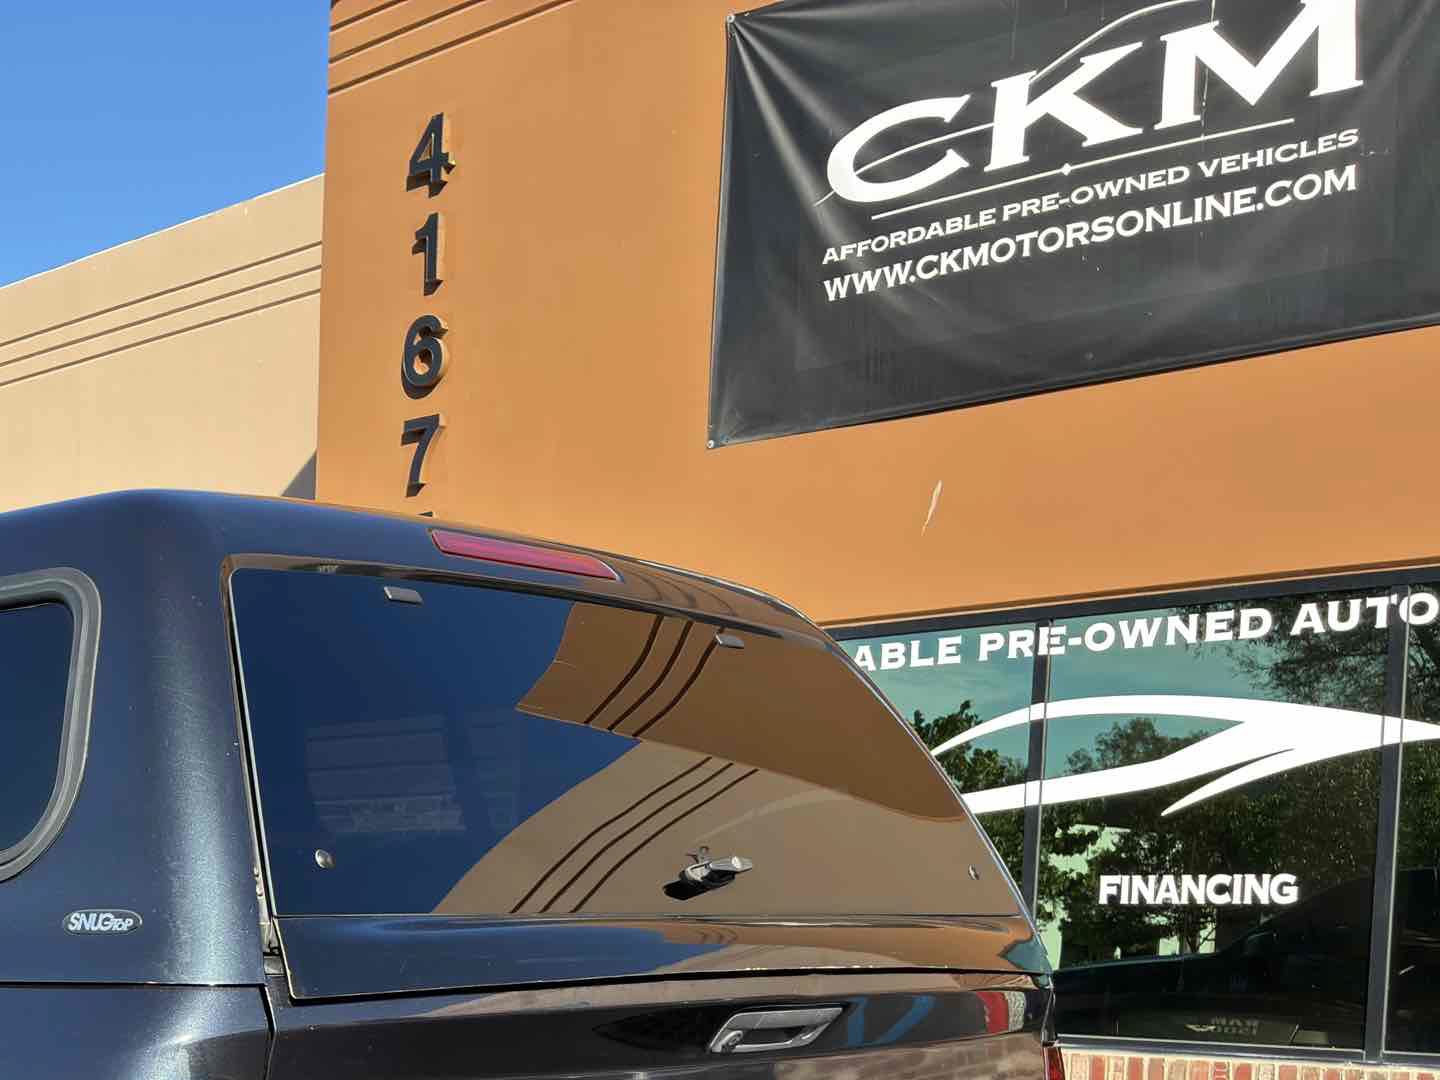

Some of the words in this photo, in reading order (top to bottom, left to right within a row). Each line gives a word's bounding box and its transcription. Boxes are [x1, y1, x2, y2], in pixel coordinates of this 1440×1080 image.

[826, 0, 1363, 203] CKM
[822, 208, 997, 265] AFFORDABLE
[1002, 166, 1191, 223] PRE-OWNED
[1198, 128, 1360, 179] VEHICLES
[823, 164, 1358, 302] WWW.CKMOTORSONLINE.COM
[400, 112, 450, 517] 4167
[977, 607, 1273, 662] PRE-OWNED
[1098, 872, 1299, 905] FINANCING
